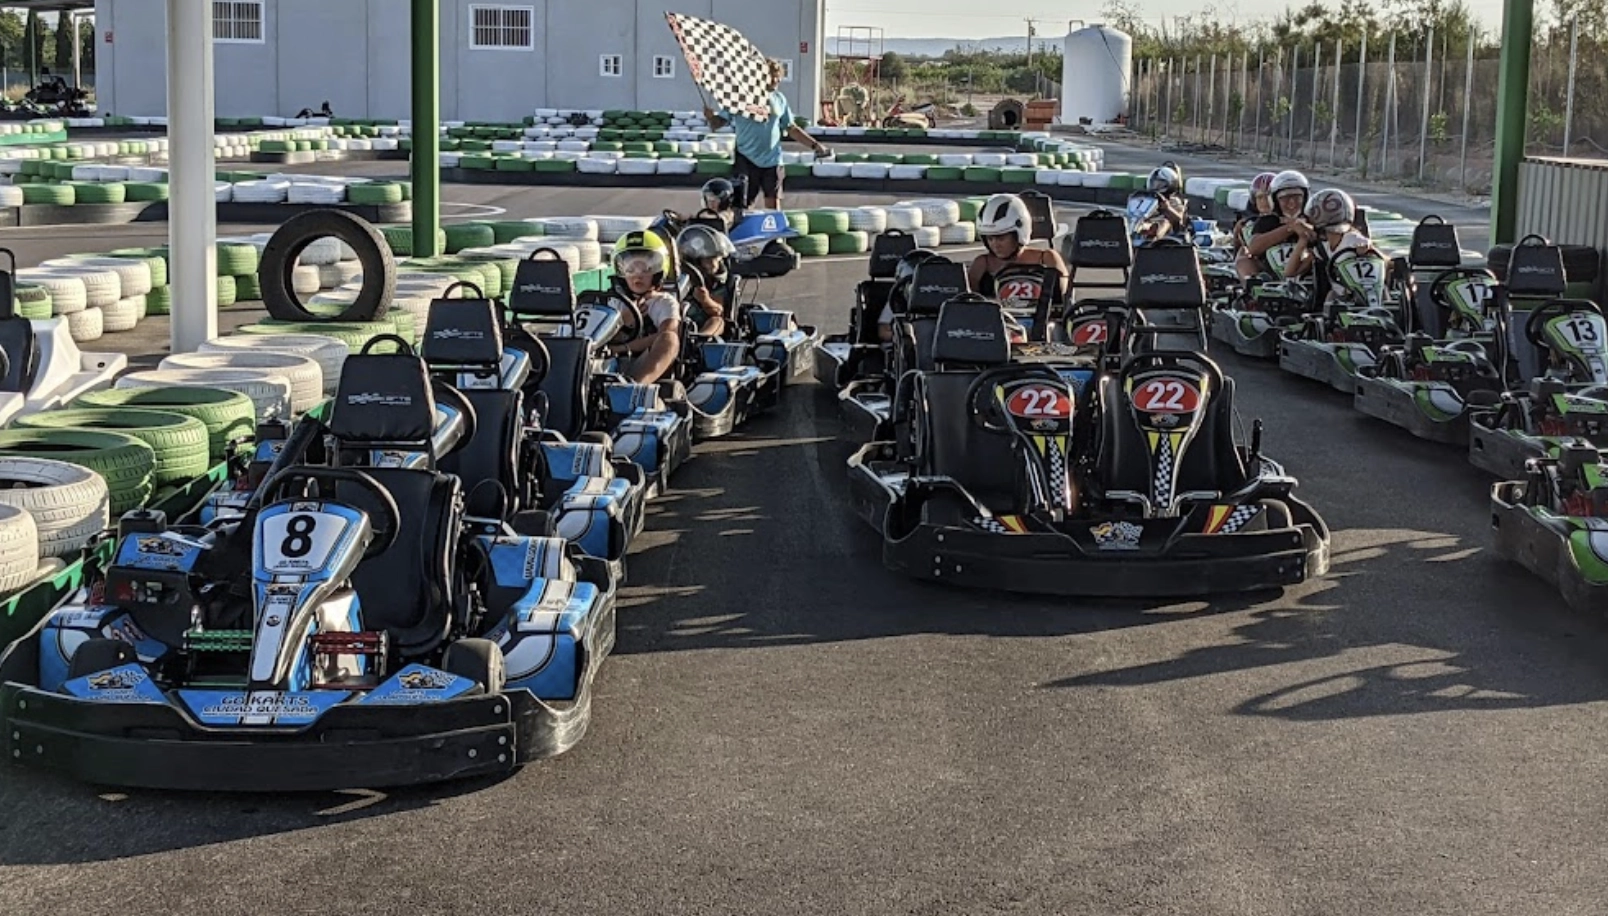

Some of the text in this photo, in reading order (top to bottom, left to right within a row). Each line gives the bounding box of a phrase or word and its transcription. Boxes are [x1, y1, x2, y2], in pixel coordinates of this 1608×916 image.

[1353, 262, 1376, 279] 12
[1008, 281, 1034, 299] 23
[1086, 323, 1107, 343] 2
[1565, 319, 1598, 342] 13
[1021, 389, 1060, 416] 22
[1146, 382, 1185, 410] 22
[280, 514, 316, 558] 8
[250, 695, 310, 705] KARTS
